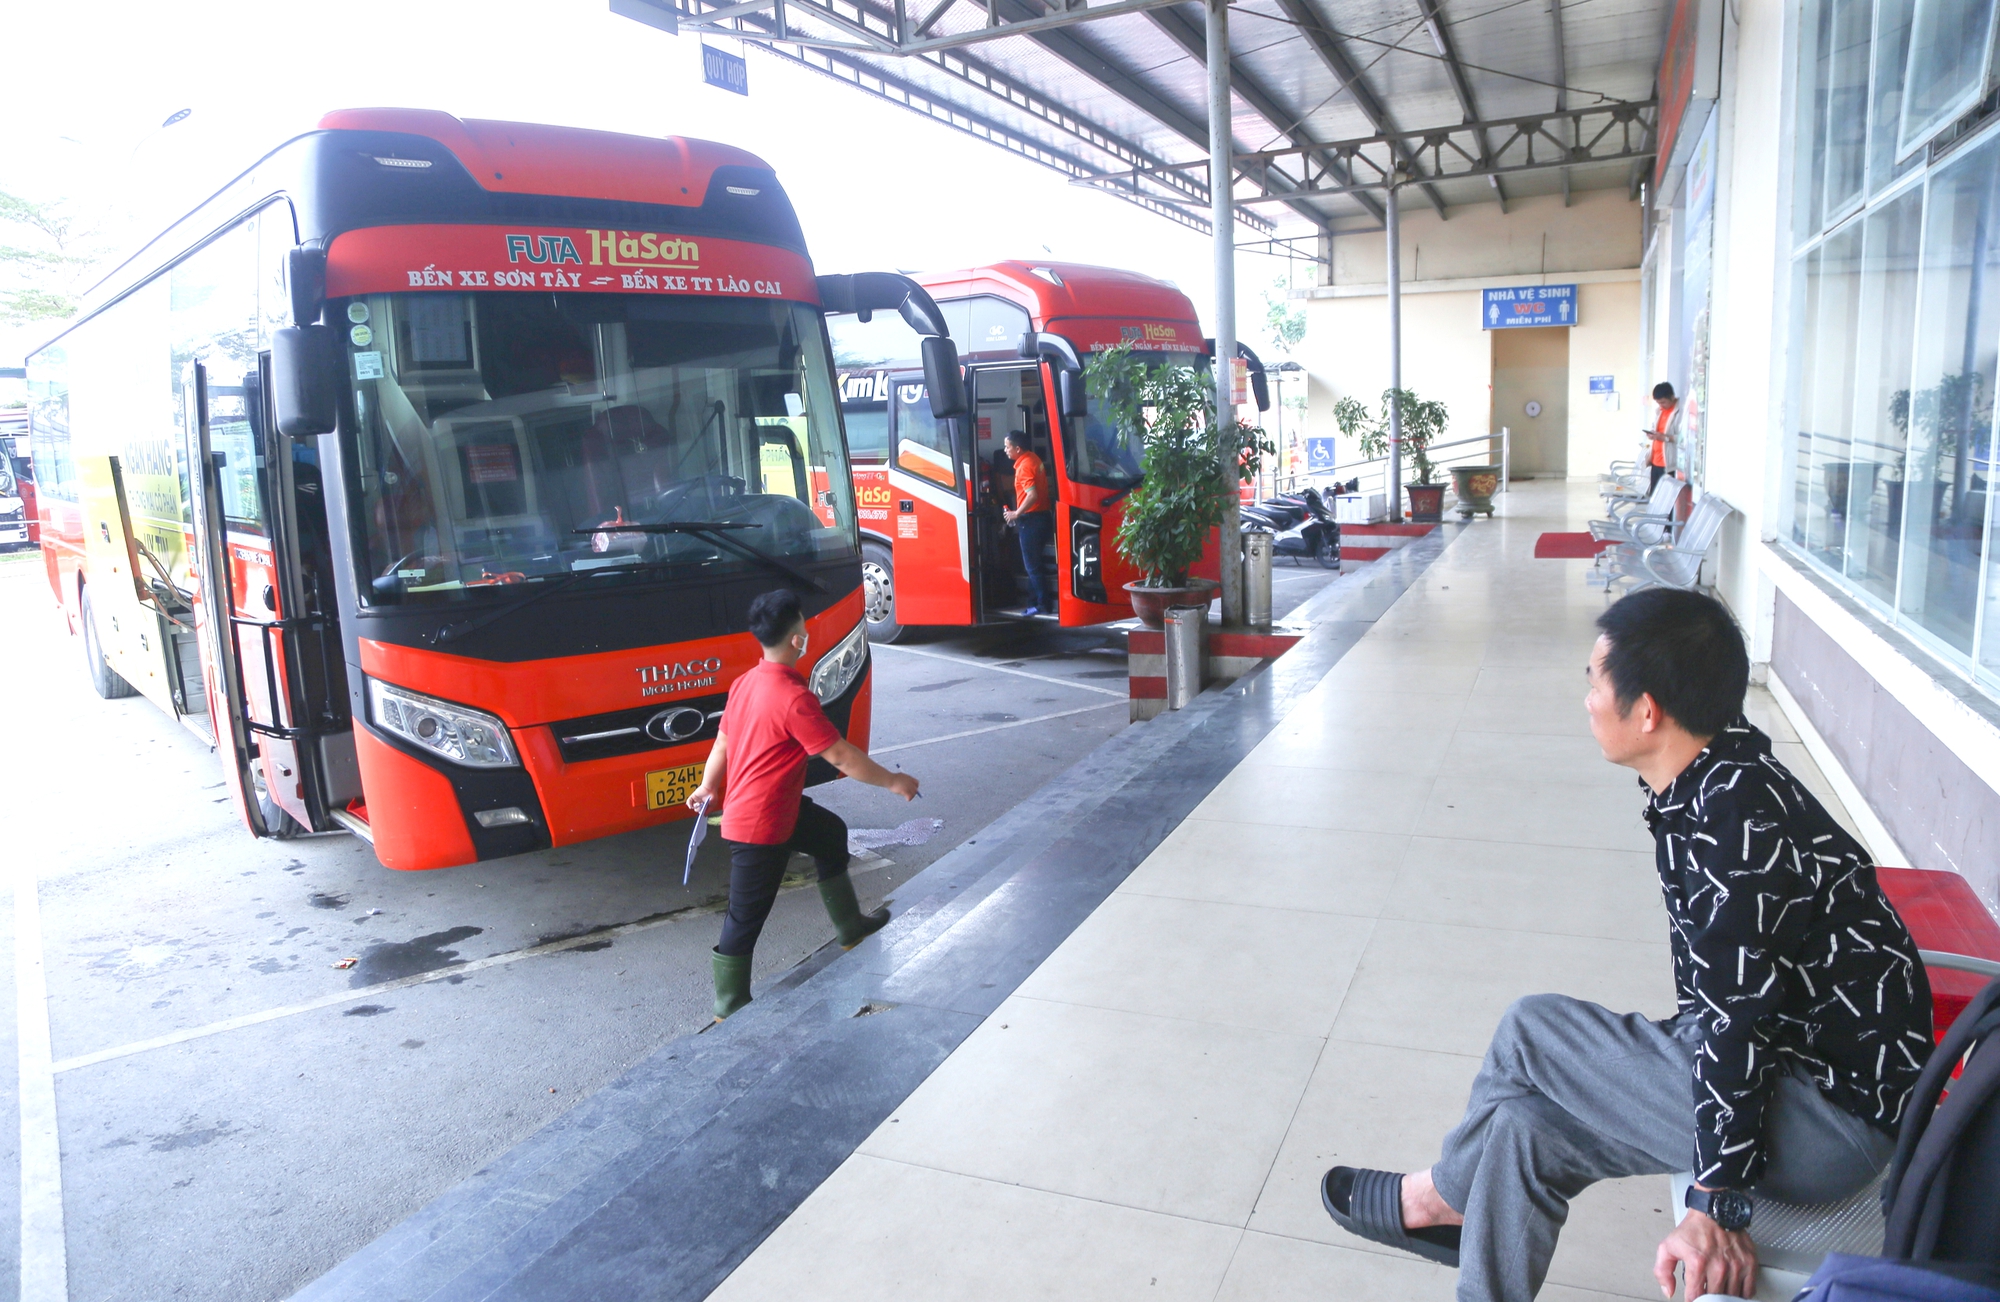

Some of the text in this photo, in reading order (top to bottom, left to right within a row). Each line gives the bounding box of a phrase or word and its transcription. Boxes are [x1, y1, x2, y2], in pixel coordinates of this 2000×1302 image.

[705, 52, 745, 90] QUỲ HỢP
[505, 229, 699, 268] FUTA HàSơn
[407, 264, 782, 295] BẾN XE SƠN TÂY BẾN XE TT LÀO CAI
[1489, 287, 1571, 302] NHÀ VỆ SINH
[1514, 301, 1546, 315] WC
[1535, 315, 1552, 324] PHÍ
[1121, 323, 1176, 341] FUTA HàSơn
[1090, 341, 1105, 351] BẾN
[635, 657, 722, 684] THACO
[642, 676, 718, 697] MOB HOME
[667, 766, 696, 787] 24H
